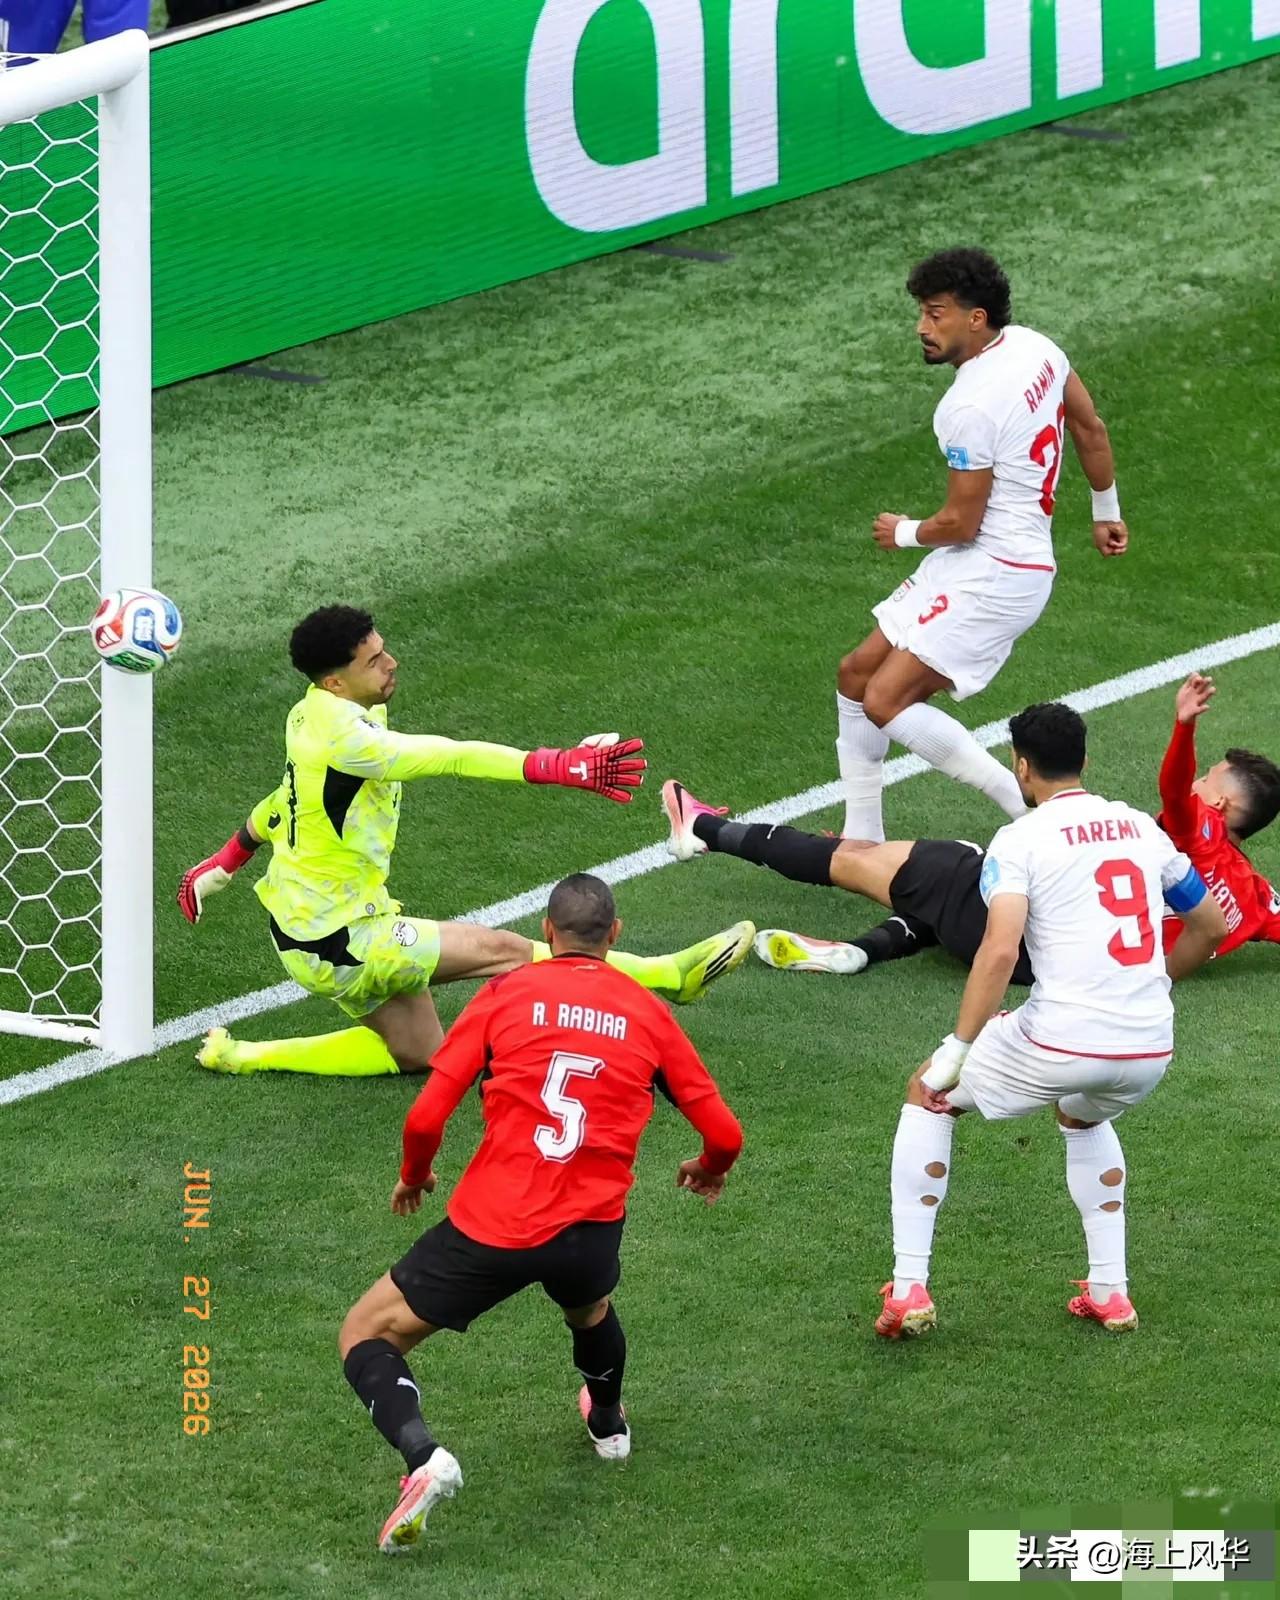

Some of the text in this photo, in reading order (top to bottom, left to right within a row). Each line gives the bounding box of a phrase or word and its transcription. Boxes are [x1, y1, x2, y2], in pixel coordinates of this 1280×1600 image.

[1022, 359, 1056, 414] RAMIN
[1060, 819, 1141, 846] TAREMI
[1094, 858, 1155, 967] 9
[532, 1001, 627, 1041] R. RABIAA
[533, 1050, 606, 1164] 5
